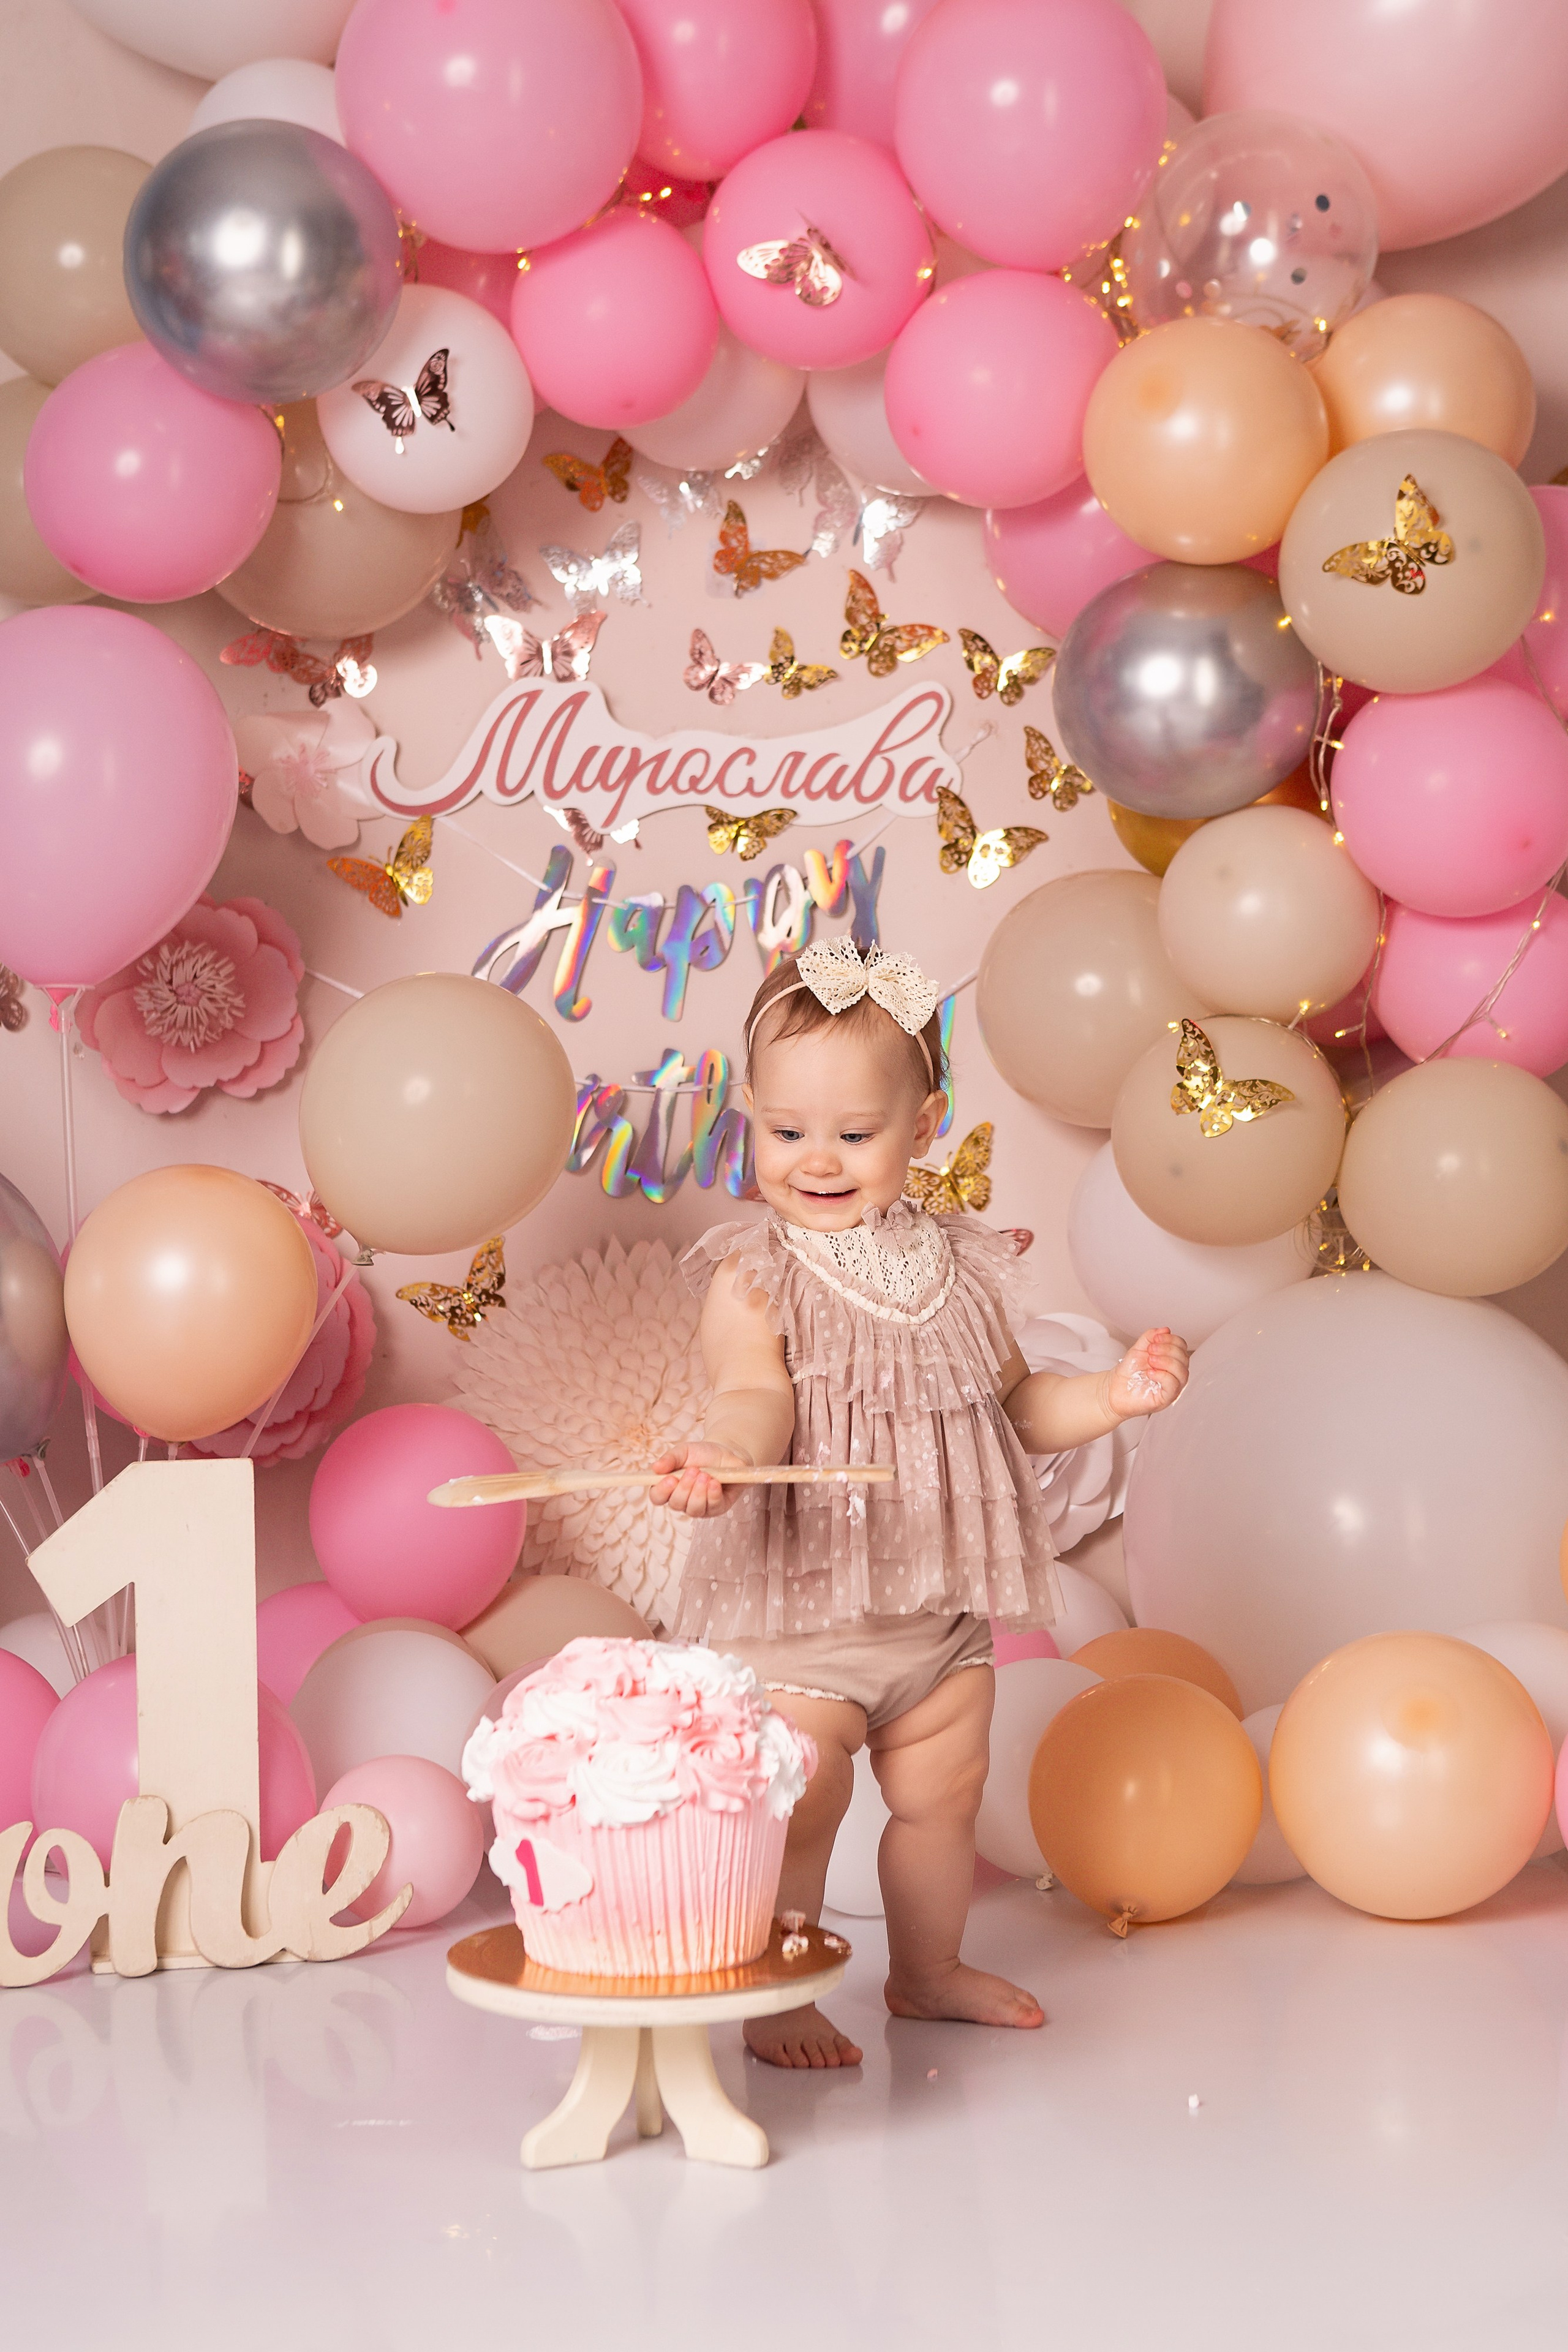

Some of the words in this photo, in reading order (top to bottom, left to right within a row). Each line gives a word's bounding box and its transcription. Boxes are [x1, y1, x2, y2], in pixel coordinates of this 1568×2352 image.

[370, 688, 954, 829] Мирослава
[471, 839, 886, 1022] Happy
[26, 1457, 261, 1954] 1
[0, 1794, 414, 1988] one
[515, 1838, 545, 1907] 1
